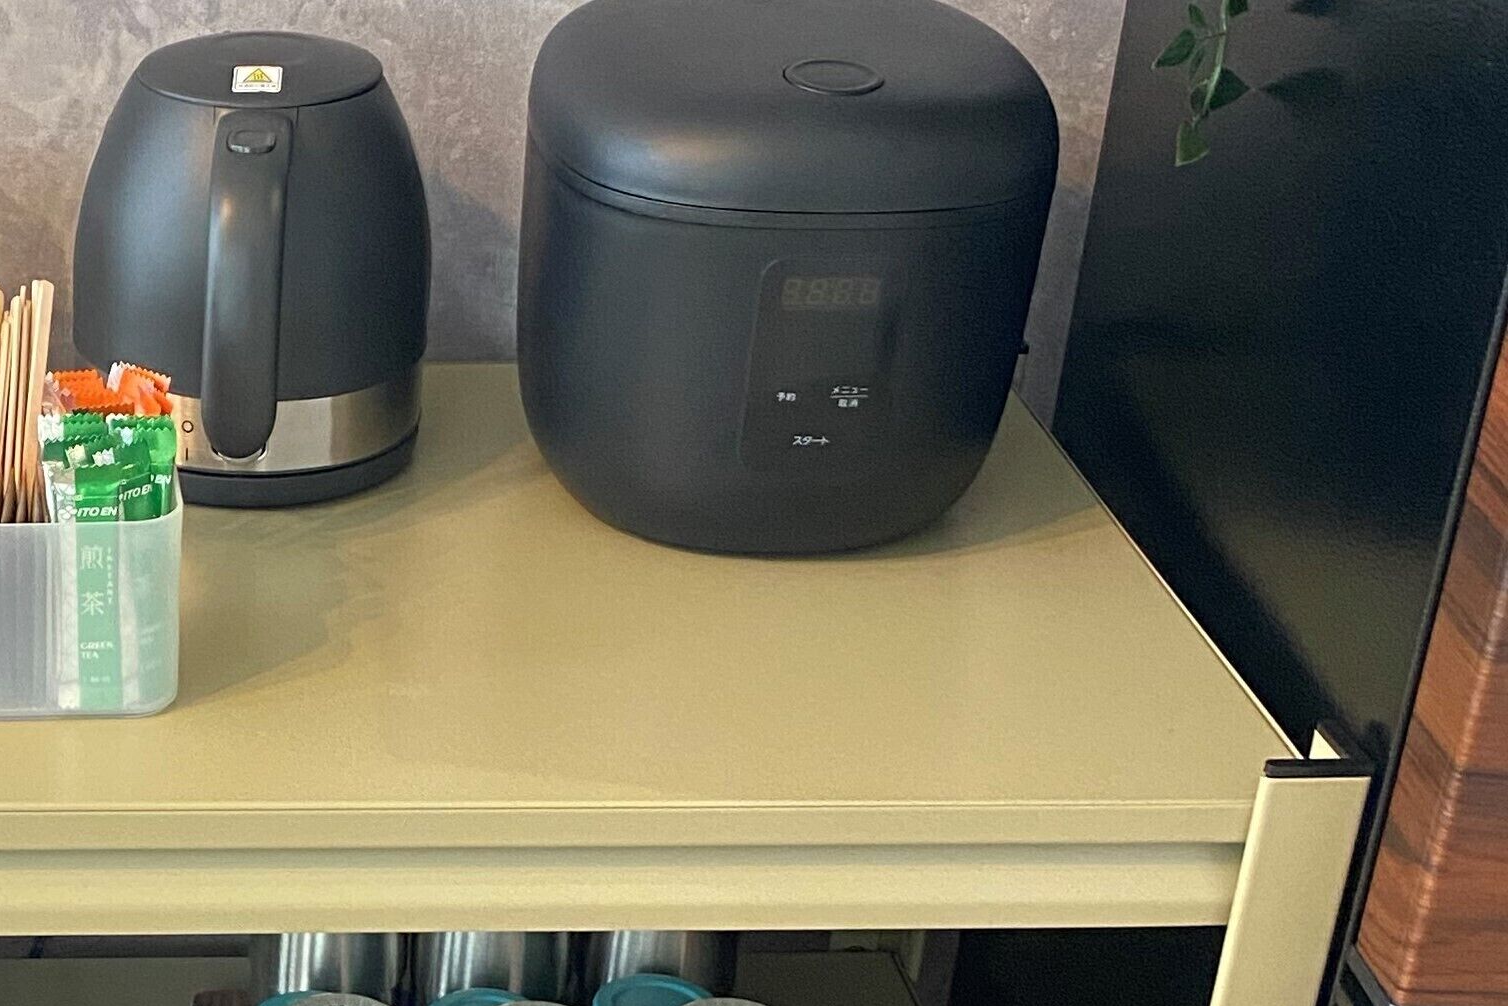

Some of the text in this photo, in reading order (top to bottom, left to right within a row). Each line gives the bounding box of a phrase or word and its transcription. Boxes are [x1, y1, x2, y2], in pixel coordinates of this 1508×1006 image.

[792, 435, 831, 447] スタート
[79, 545, 104, 616] 煎茶
